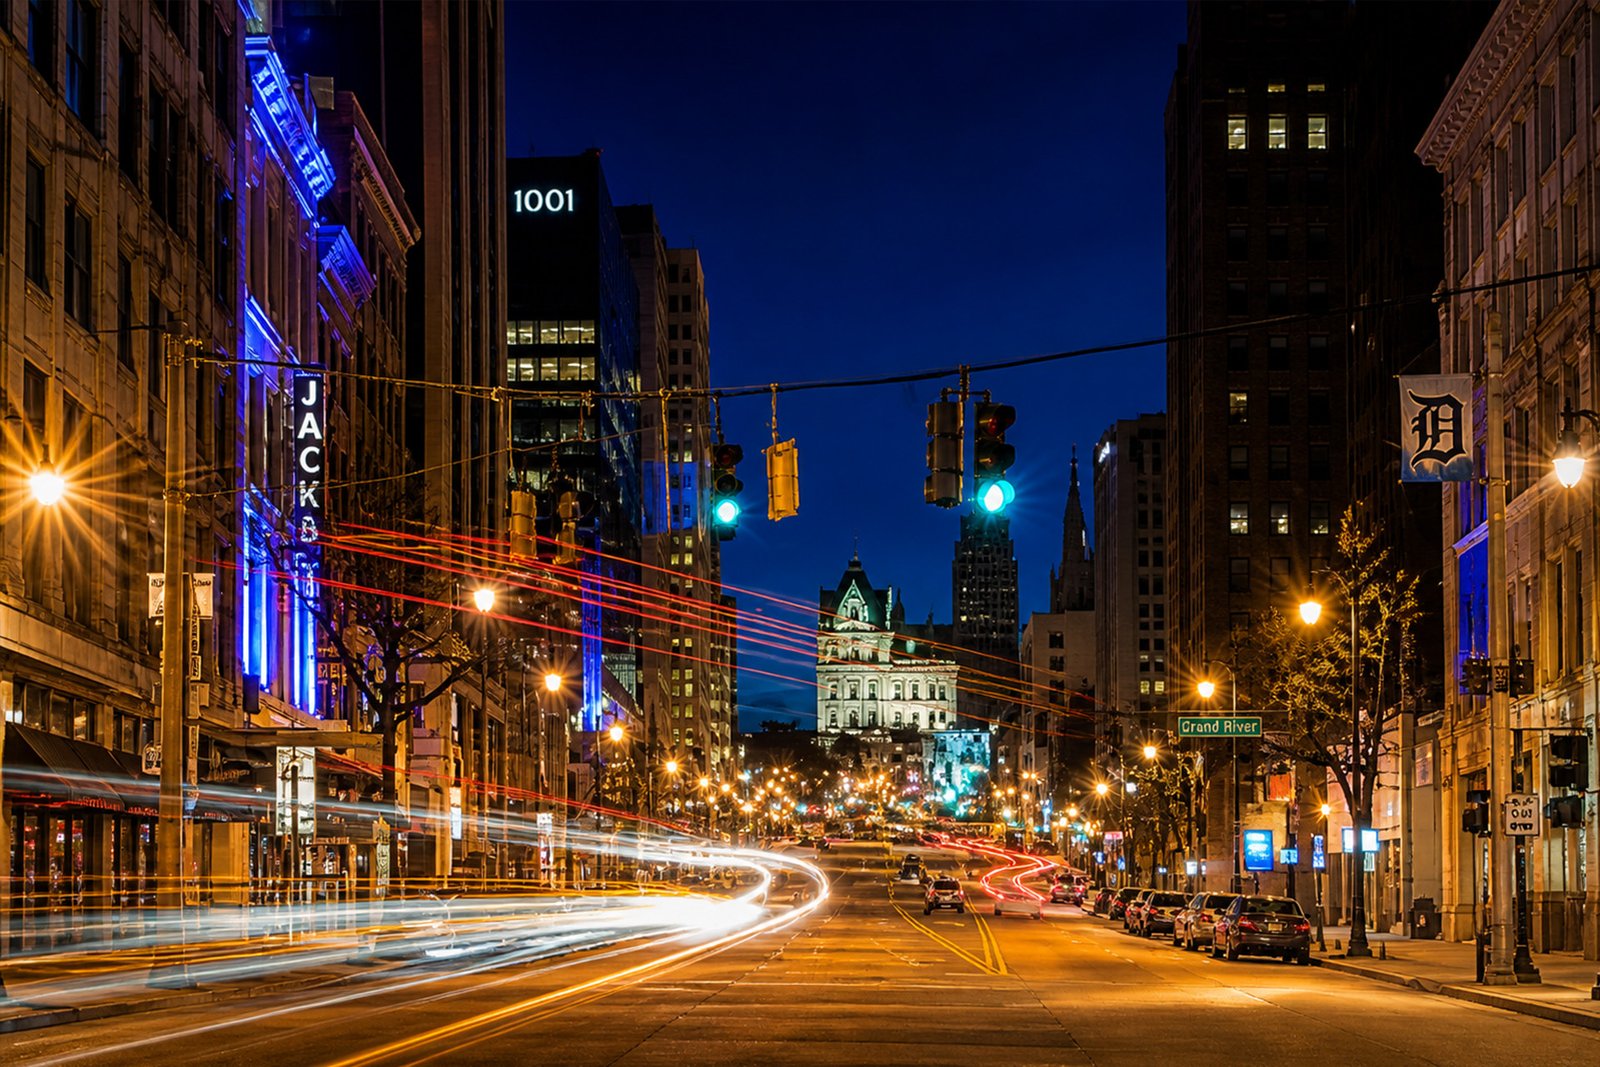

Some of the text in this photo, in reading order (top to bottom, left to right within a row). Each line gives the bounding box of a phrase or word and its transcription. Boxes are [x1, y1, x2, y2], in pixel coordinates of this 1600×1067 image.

[514, 188, 574, 213] 1001
[1406, 388, 1468, 475] D
[1181, 719, 1258, 733] Grand River
